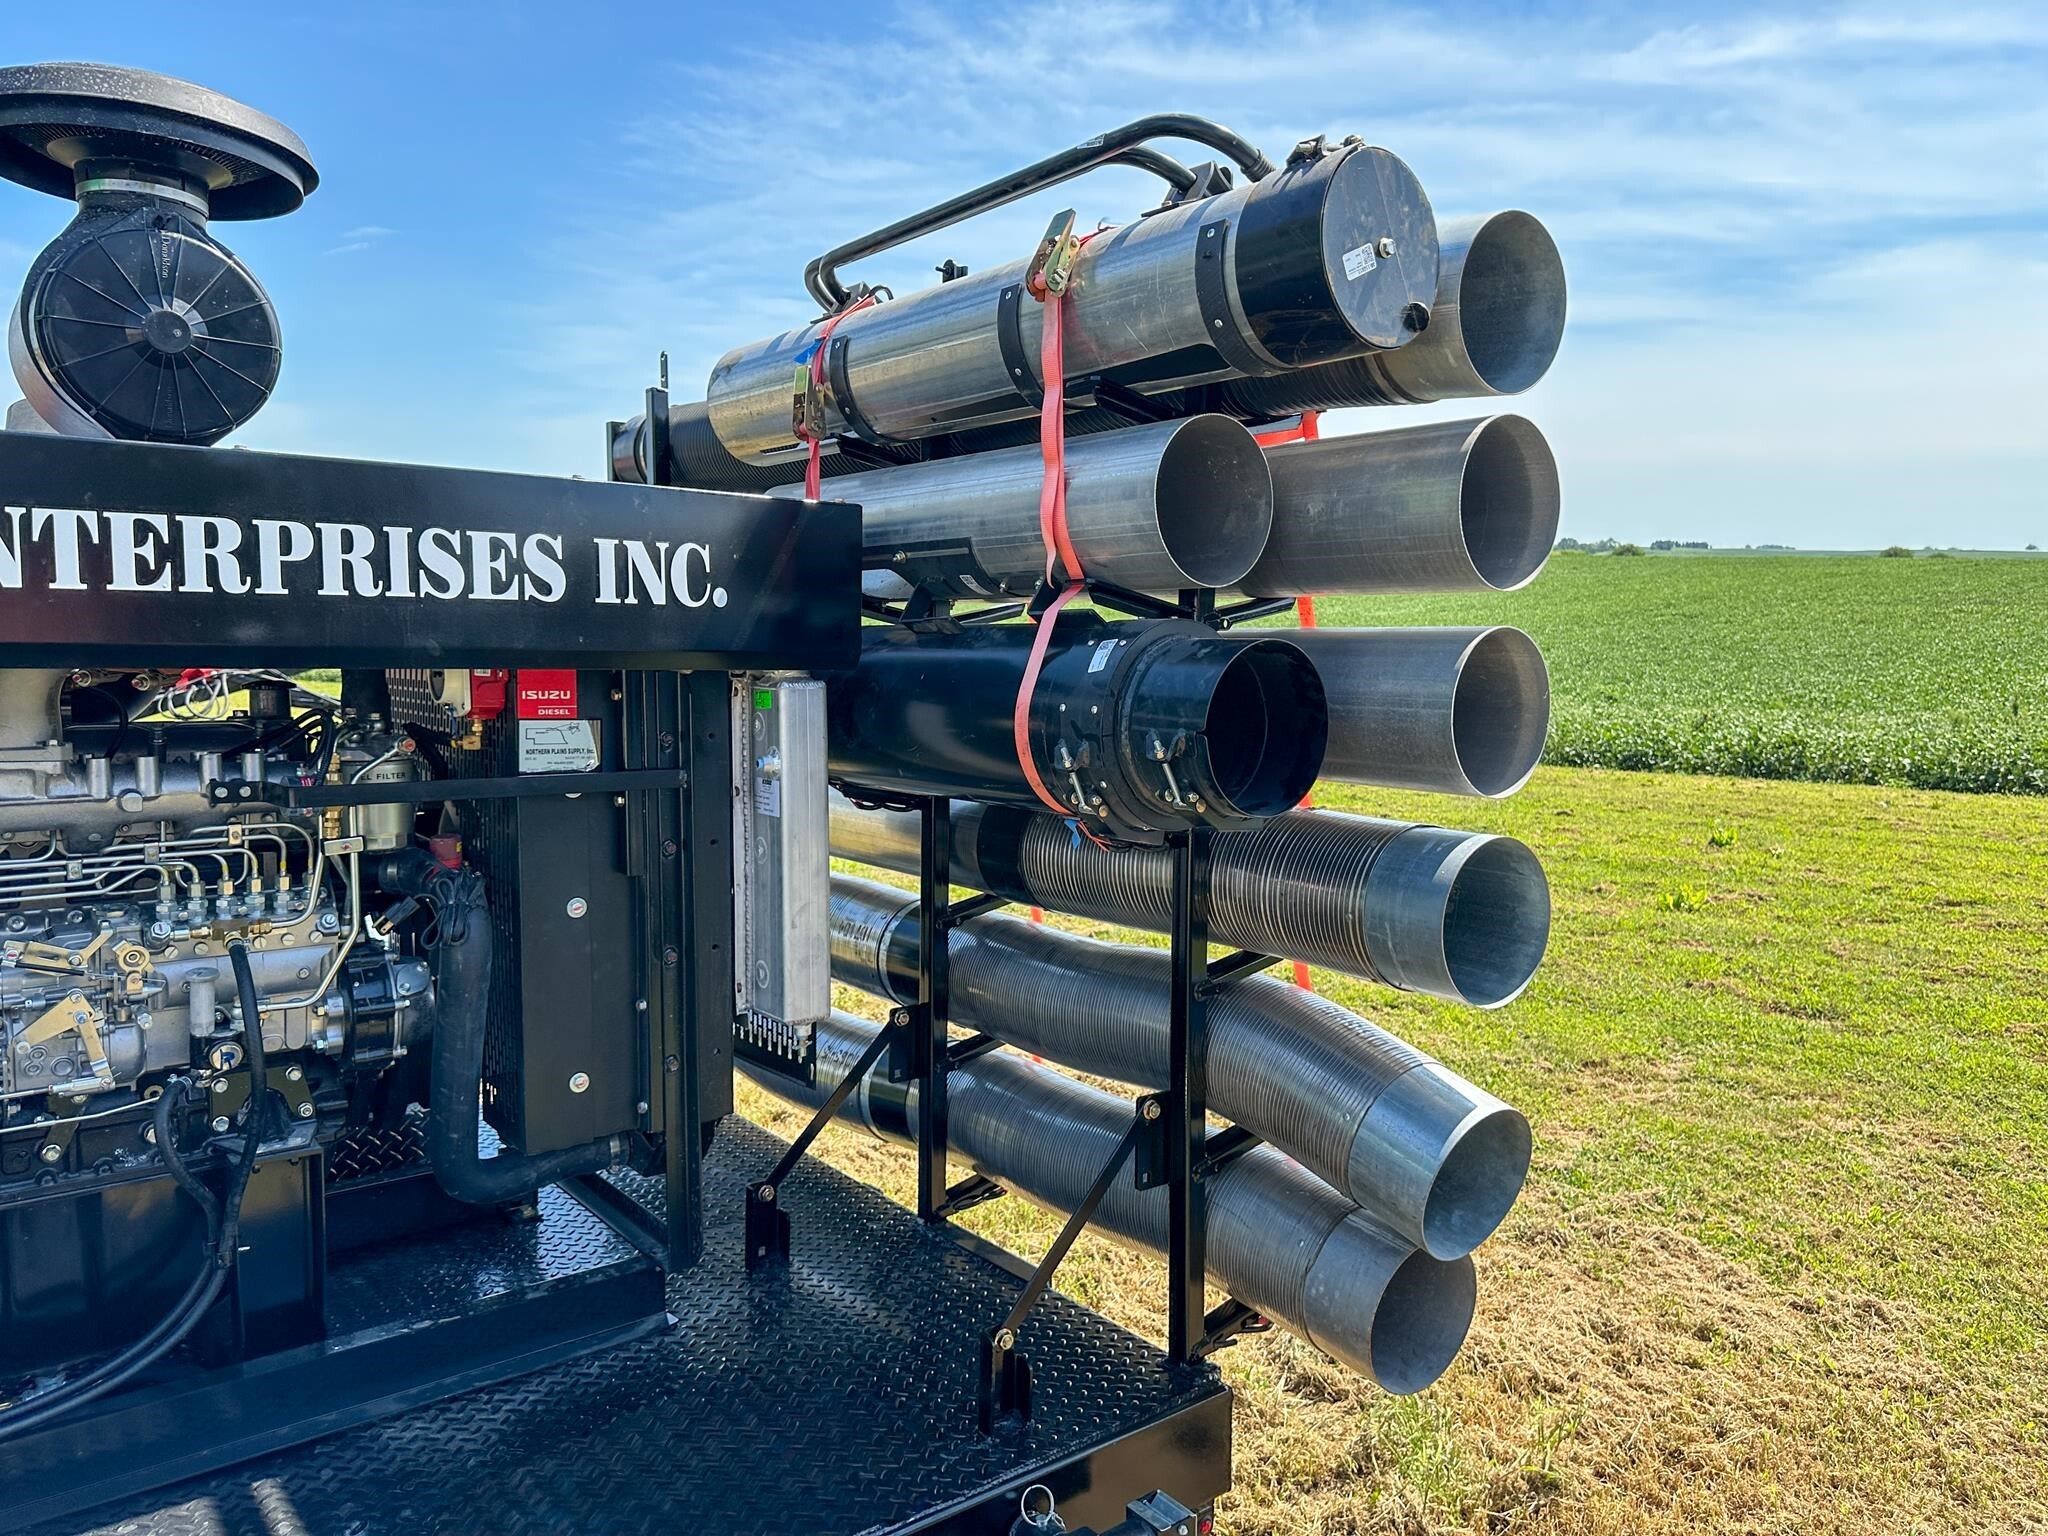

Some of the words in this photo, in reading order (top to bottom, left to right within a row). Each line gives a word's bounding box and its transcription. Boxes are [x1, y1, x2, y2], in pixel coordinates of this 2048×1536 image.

[161, 236, 171, 279] Donaldson
[593, 538, 728, 608] INC.
[522, 690, 571, 700] ISUZU
[376, 772, 406, 780] FILTER
